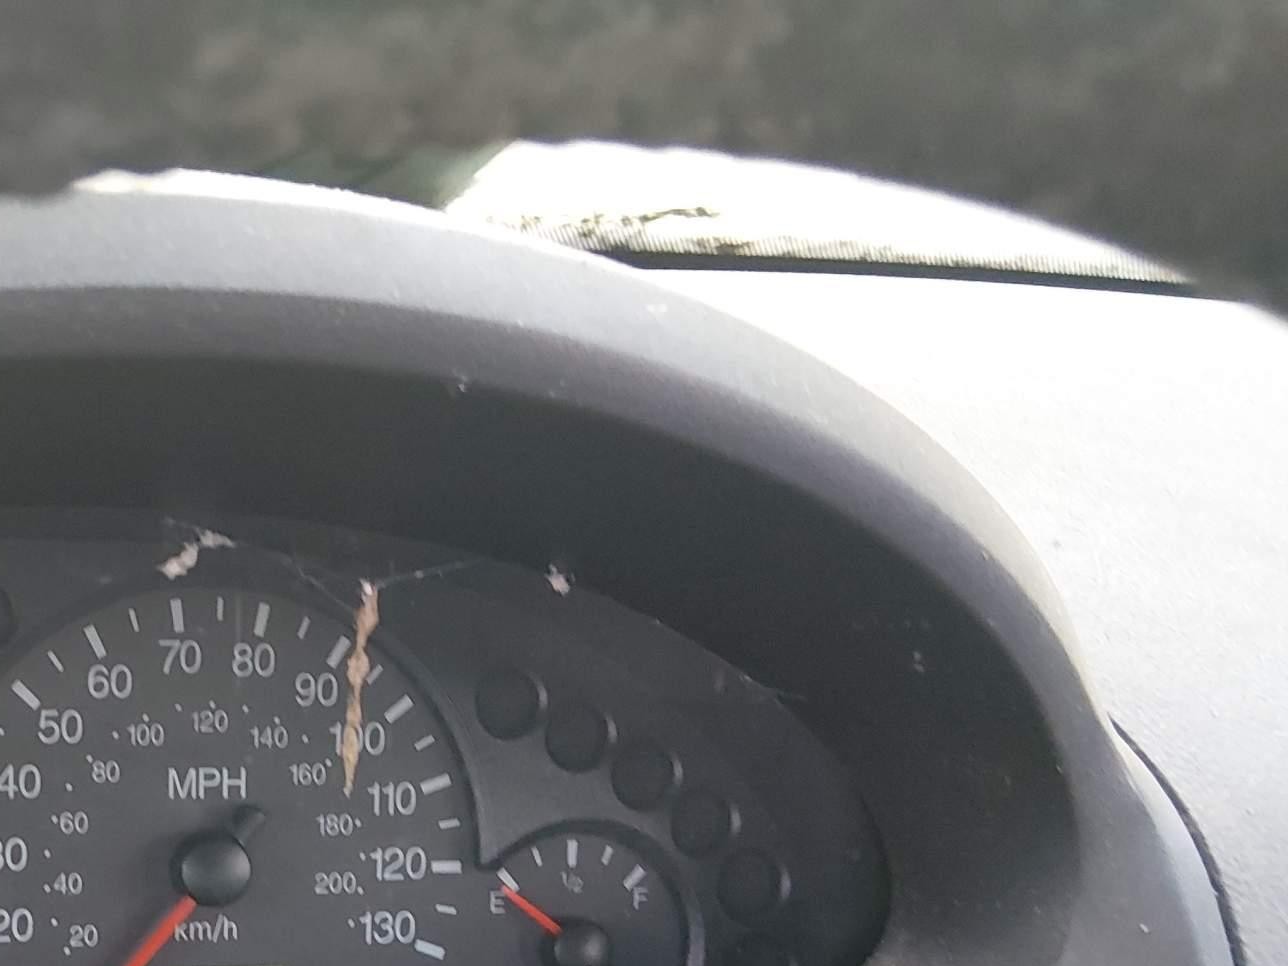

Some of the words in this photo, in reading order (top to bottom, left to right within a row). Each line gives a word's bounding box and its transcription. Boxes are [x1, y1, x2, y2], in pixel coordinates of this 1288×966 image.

[160, 639, 202, 674] 70
[231, 643, 276, 677] 80
[87, 664, 132, 699] 60
[295, 672, 338, 706] 90
[38, 710, 83, 744] 50
[192, 710, 228, 732] 120
[126, 723, 164, 746] 100
[251, 726, 288, 749] 140
[92, 760, 120, 782] 80
[290, 762, 326, 786] 160
[167, 767, 247, 800] MPH
[368, 781, 416, 815] 110
[59, 811, 89, 833] 60
[317, 815, 353, 836] 180
[374, 847, 426, 880] 120
[54, 873, 82, 893] 40
[314, 873, 356, 895] 200
[489, 890, 506, 914] E
[633, 886, 649, 910] F
[69, 926, 98, 948] 20
[174, 917, 238, 941] km/h
[359, 912, 415, 945] 130
